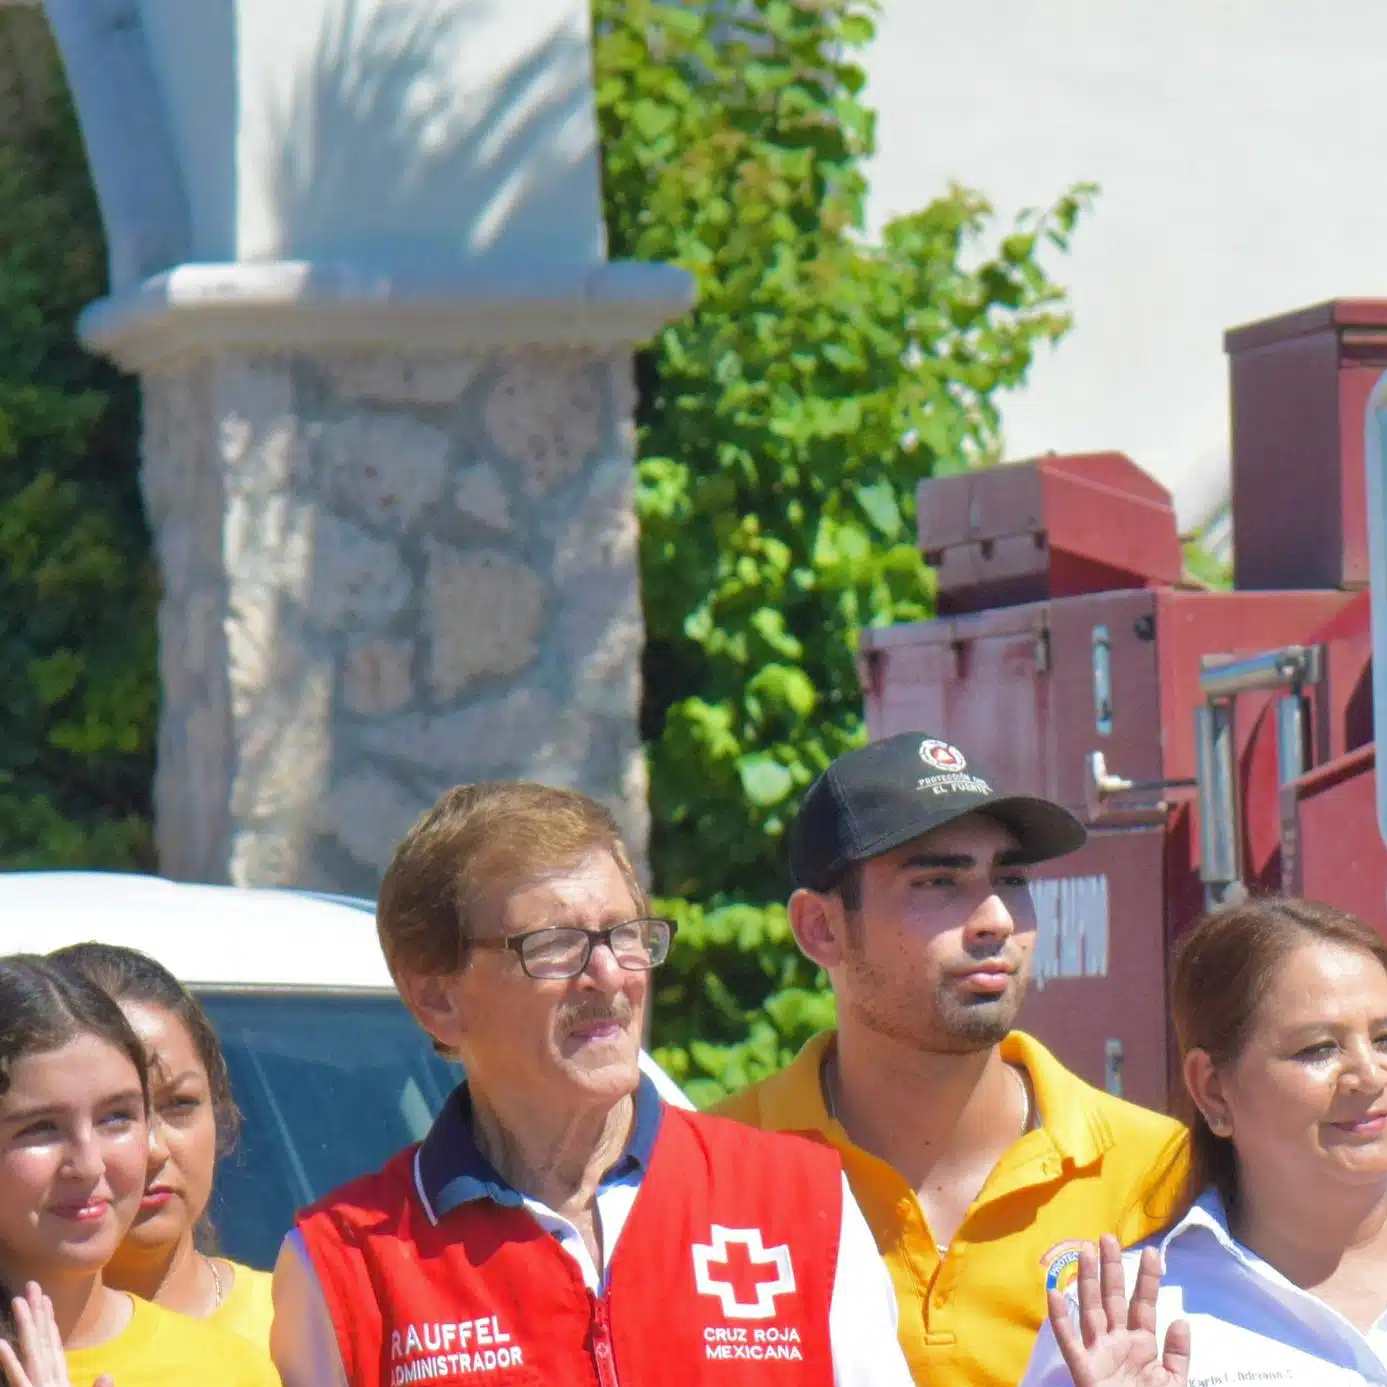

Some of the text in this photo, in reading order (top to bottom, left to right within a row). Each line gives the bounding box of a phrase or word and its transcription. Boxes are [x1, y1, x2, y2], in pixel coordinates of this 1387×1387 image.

[391, 1315, 510, 1361] RAUFFEL
[704, 1327, 801, 1342] CRUZ ROJA
[705, 1344, 803, 1360] MEXICANA
